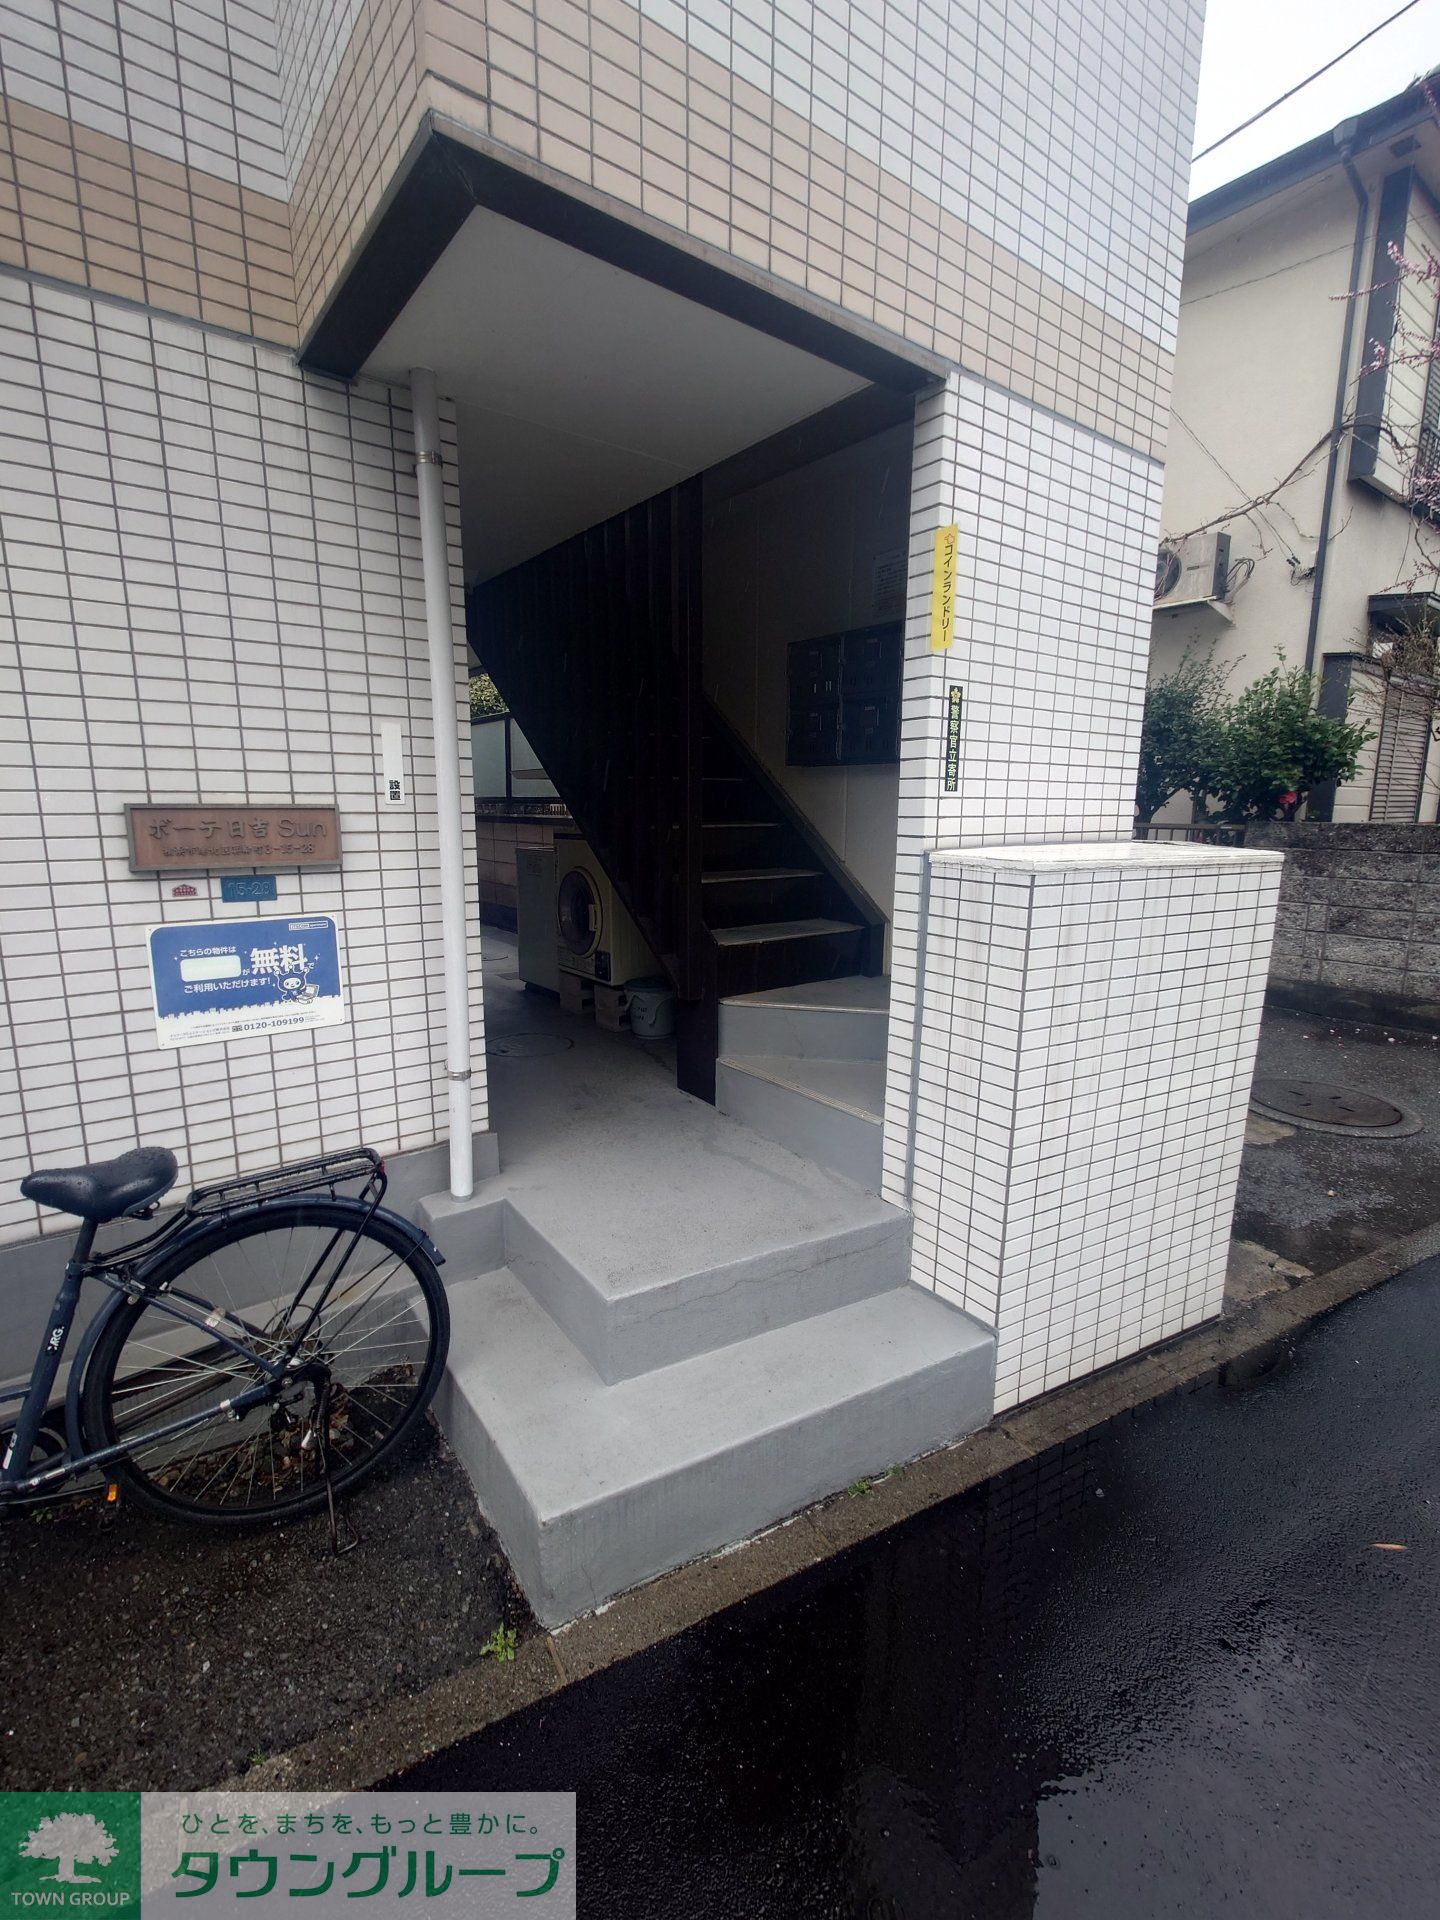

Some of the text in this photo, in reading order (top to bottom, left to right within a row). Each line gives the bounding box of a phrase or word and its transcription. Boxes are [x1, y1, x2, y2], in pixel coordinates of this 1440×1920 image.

[941, 544, 954, 642] コインランドリー
[947, 704, 960, 791] 警察官立寄所
[278, 819, 328, 838] Sun
[179, 945, 237, 958] こちらの物件は
[243, 1016, 305, 1032] 0120-109199
